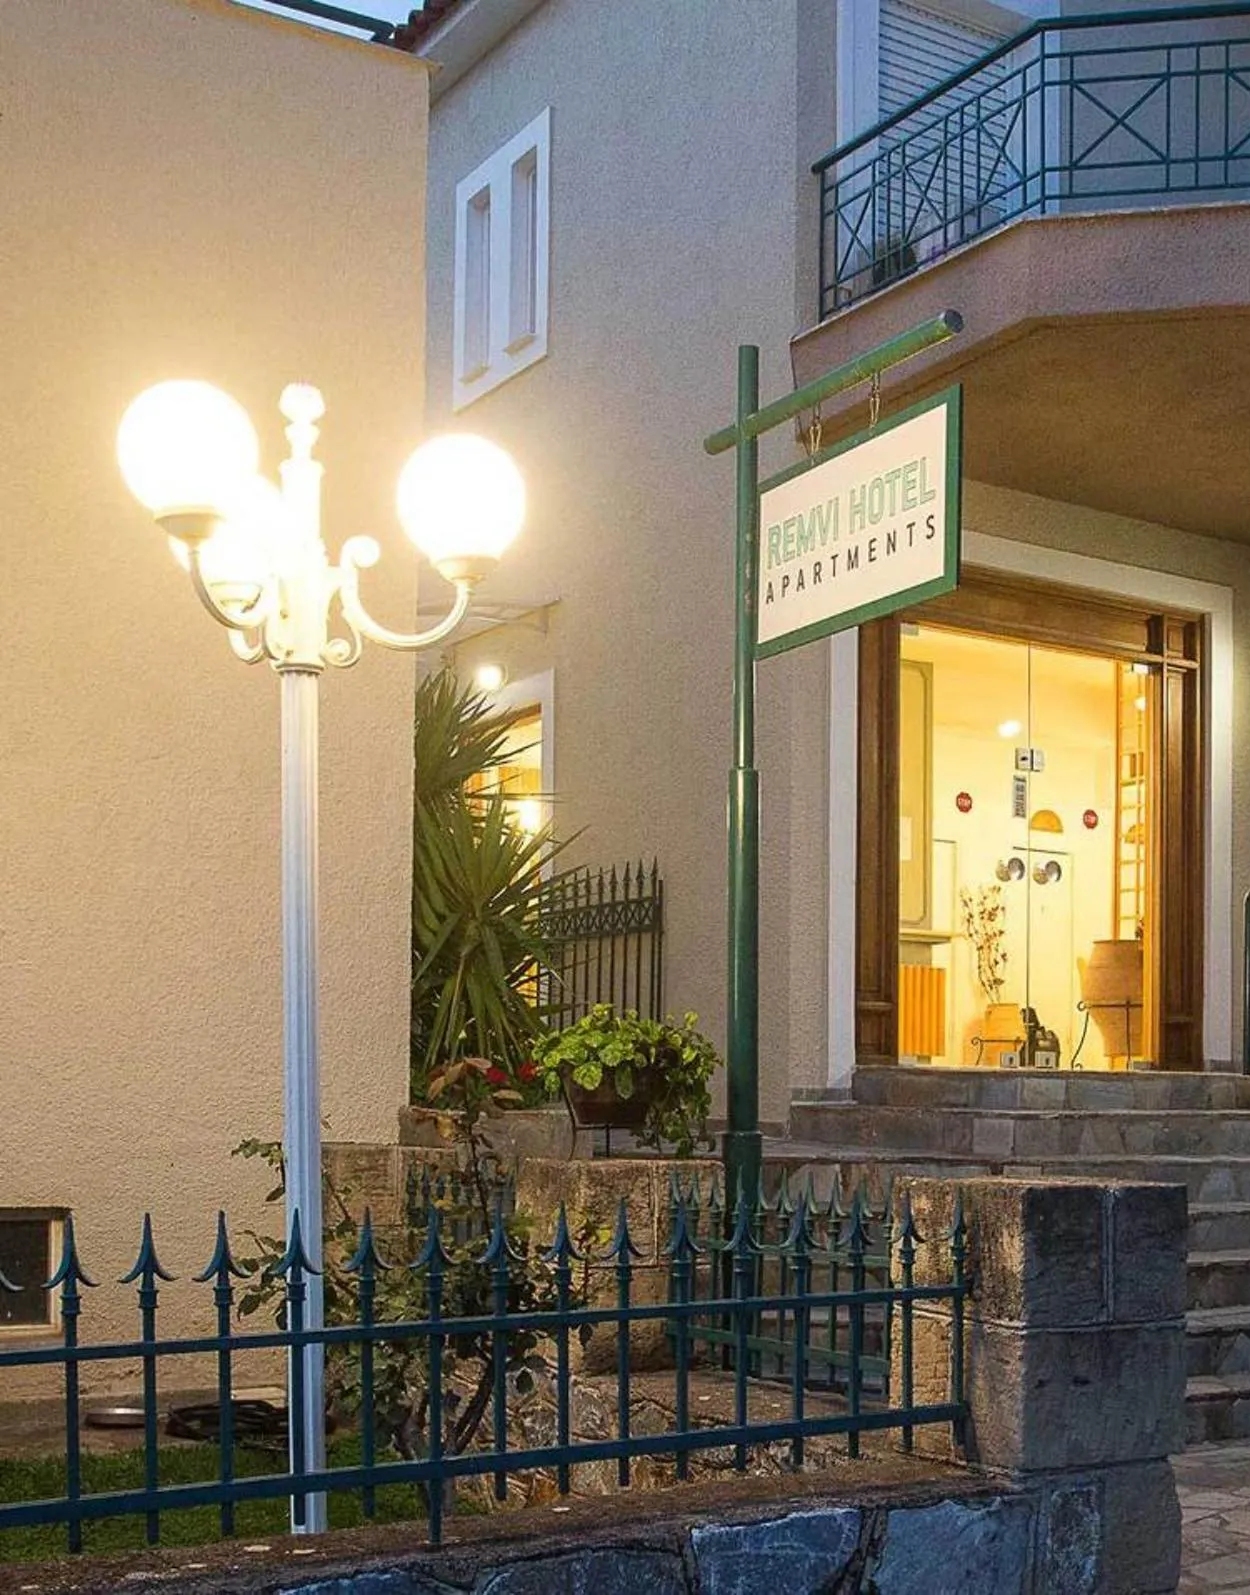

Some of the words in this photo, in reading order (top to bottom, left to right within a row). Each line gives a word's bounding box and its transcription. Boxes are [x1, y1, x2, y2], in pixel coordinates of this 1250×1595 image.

[766, 514, 936, 604] APARTMENTS
[767, 496, 840, 570] REMVI
[849, 456, 936, 535] HOTEL
